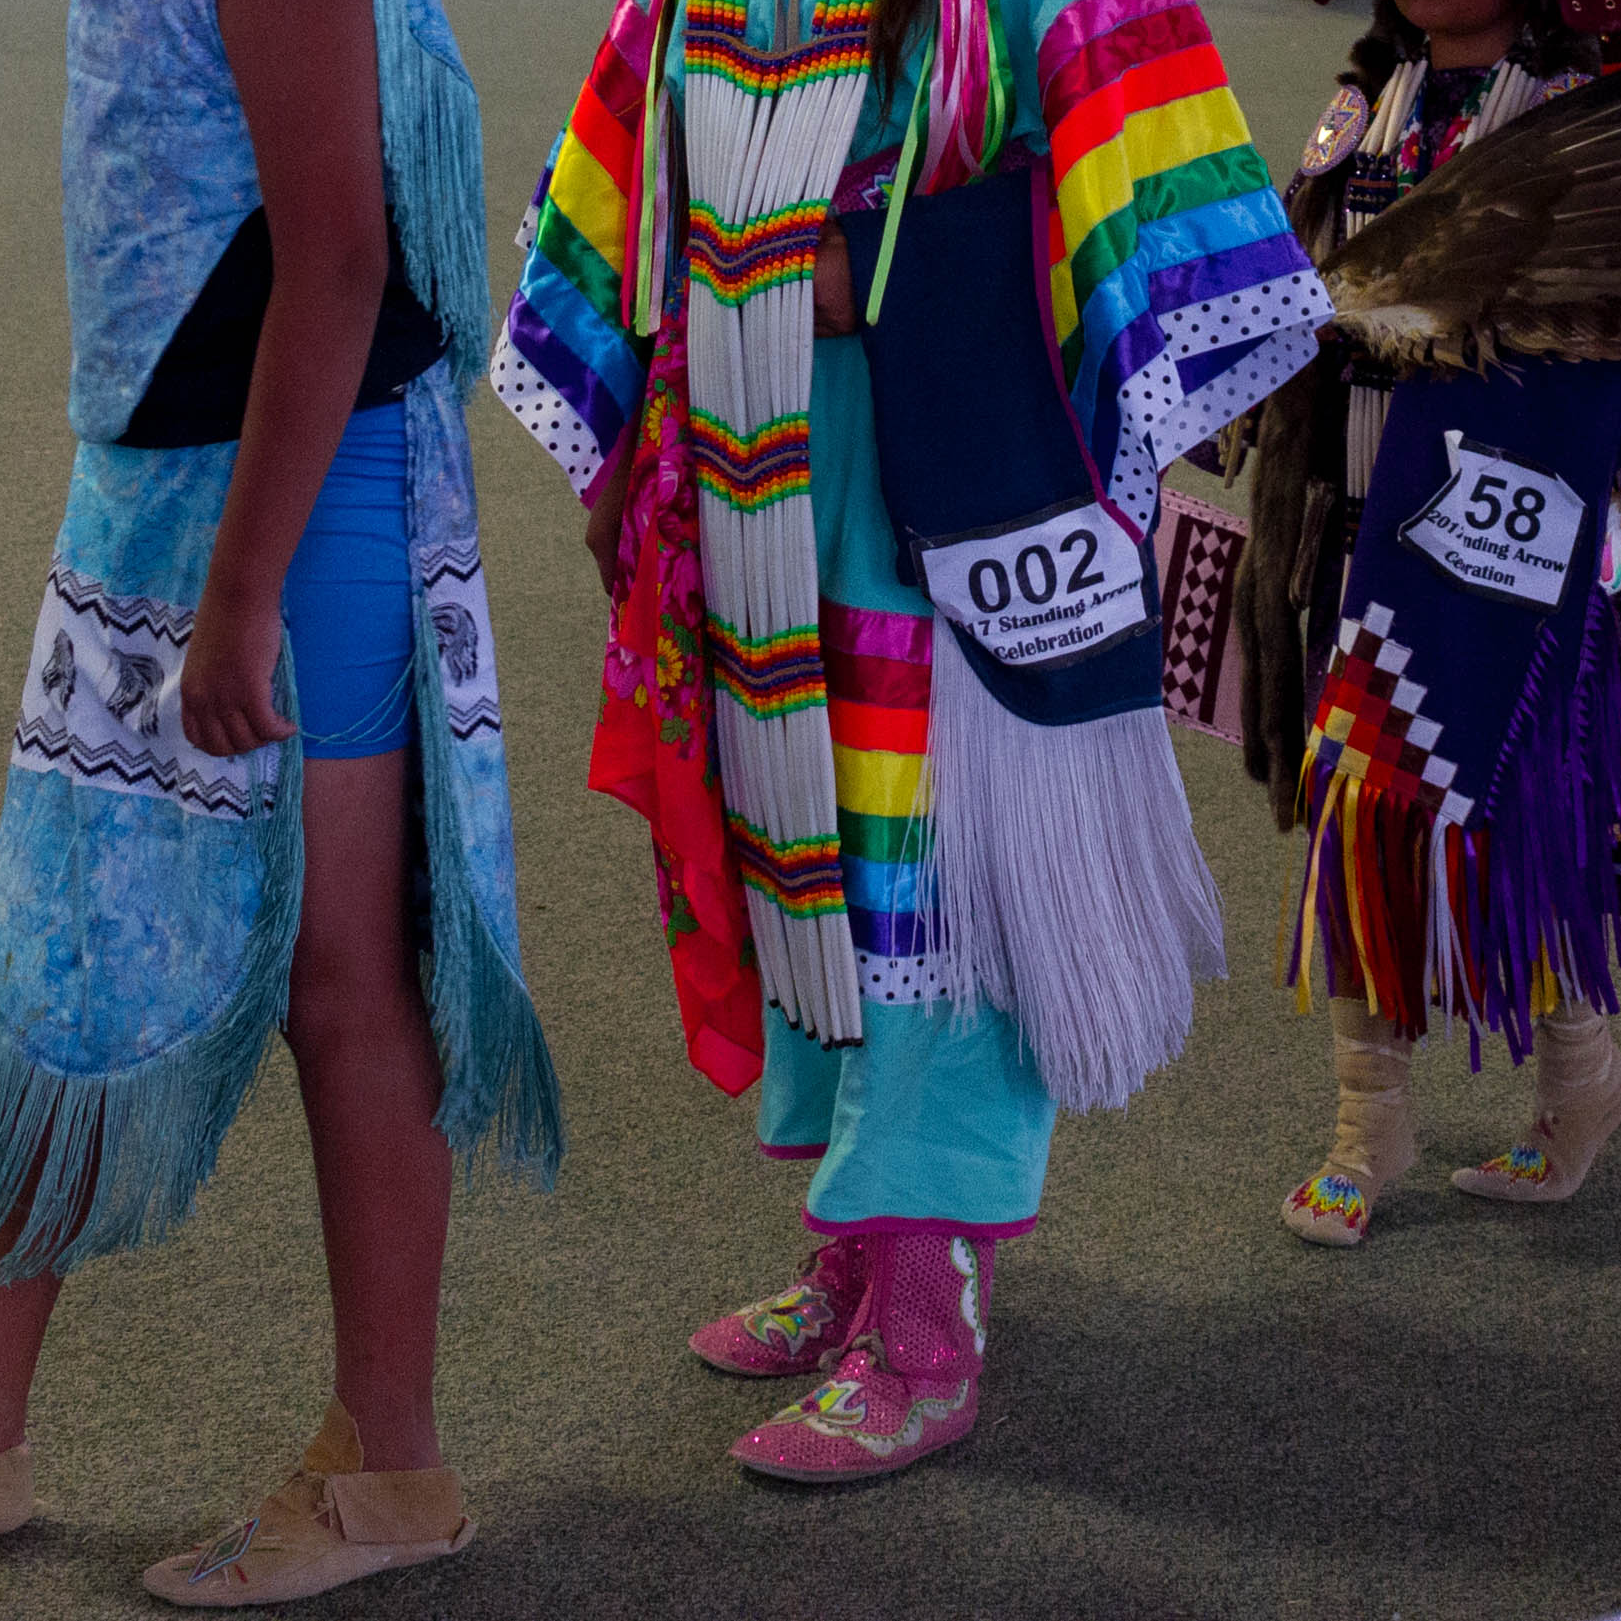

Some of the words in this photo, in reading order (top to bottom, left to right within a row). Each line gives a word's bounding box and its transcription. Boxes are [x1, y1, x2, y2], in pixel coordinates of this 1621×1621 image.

[1464, 474, 1546, 543] 58
[967, 528, 1105, 615] 002
[1512, 547, 1567, 573] Arrow
[998, 598, 1086, 633] Standing
[1090, 579, 1142, 609] Arrow
[993, 621, 1105, 661] Celebration
